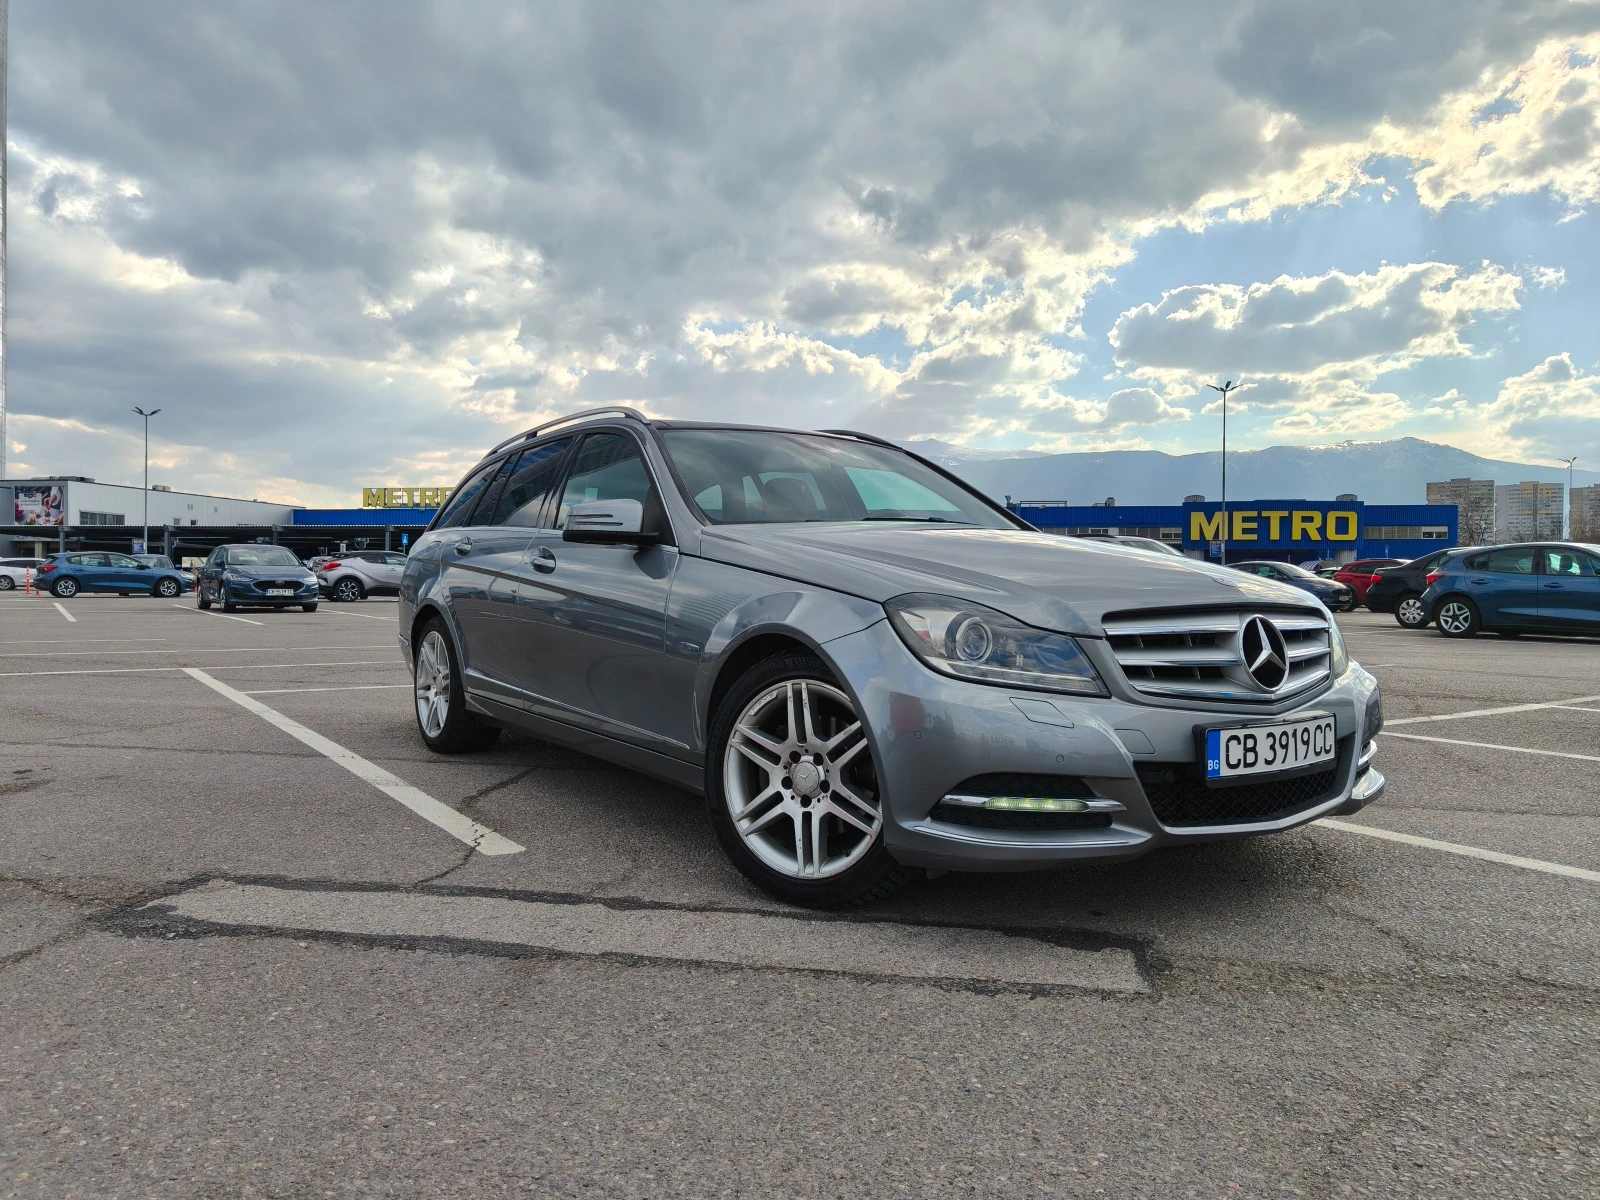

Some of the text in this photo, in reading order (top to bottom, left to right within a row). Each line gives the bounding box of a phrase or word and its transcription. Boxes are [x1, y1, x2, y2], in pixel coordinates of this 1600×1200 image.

[1190, 511, 1358, 541] METRO
[1225, 722, 1333, 770] CB 3919 CC
[1207, 759, 1220, 771] BG
